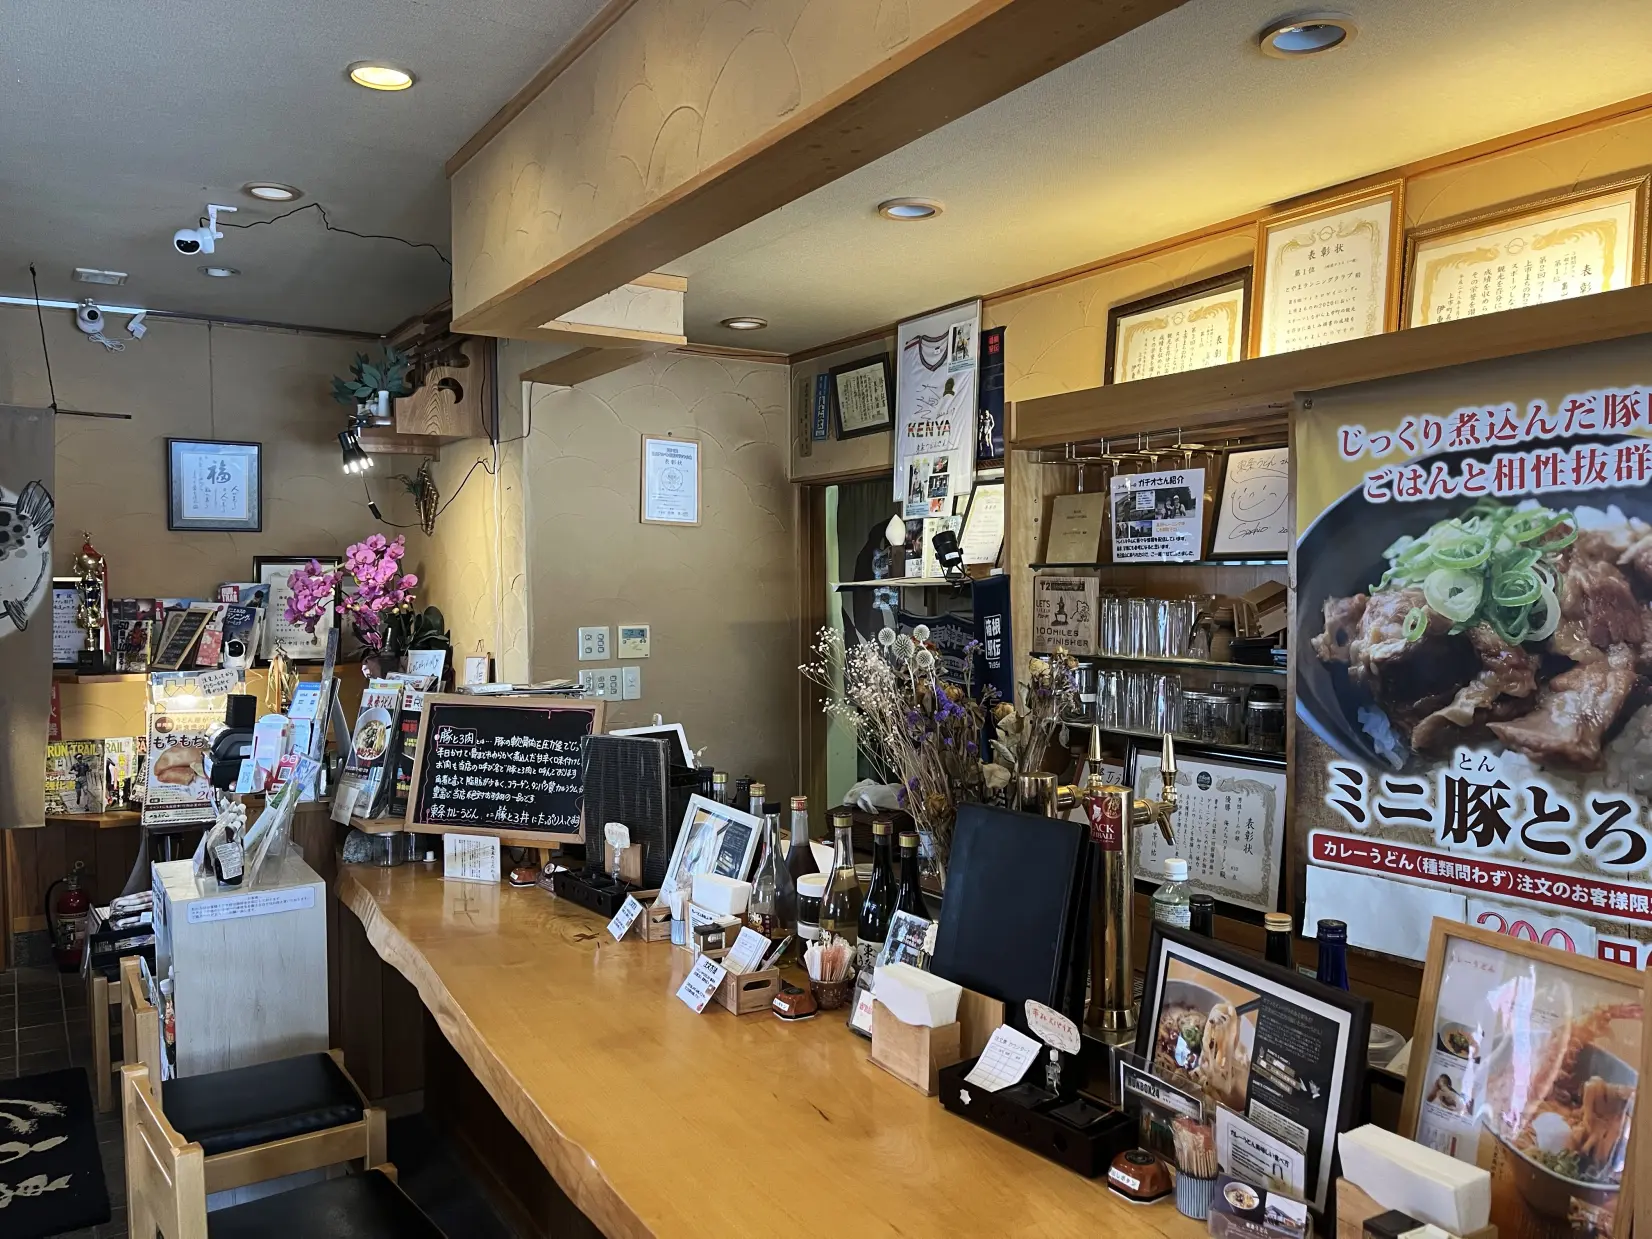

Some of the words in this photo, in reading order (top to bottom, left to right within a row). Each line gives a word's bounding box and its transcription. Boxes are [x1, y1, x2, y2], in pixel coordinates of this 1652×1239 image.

[1308, 244, 1344, 260] 表彰状
[908, 420, 950, 437] KENYA
[1340, 390, 1652, 456] じっくり煮込んだ豚
[206, 459, 231, 484] 福
[1138, 475, 1184, 487] ガチオさん紹介
[985, 617, 1001, 637] 箱根
[1047, 638, 1089, 647] FINISHER
[153, 733, 204, 749] もちもち
[1458, 752, 1496, 772] とん
[1225, 795, 1231, 812] 優勝
[1330, 766, 1647, 865] ミニ豚とろ
[1243, 817, 1255, 856] 表彰状
[1323, 840, 1652, 916] カレーうどん（種類問わず）注文のお客様限
